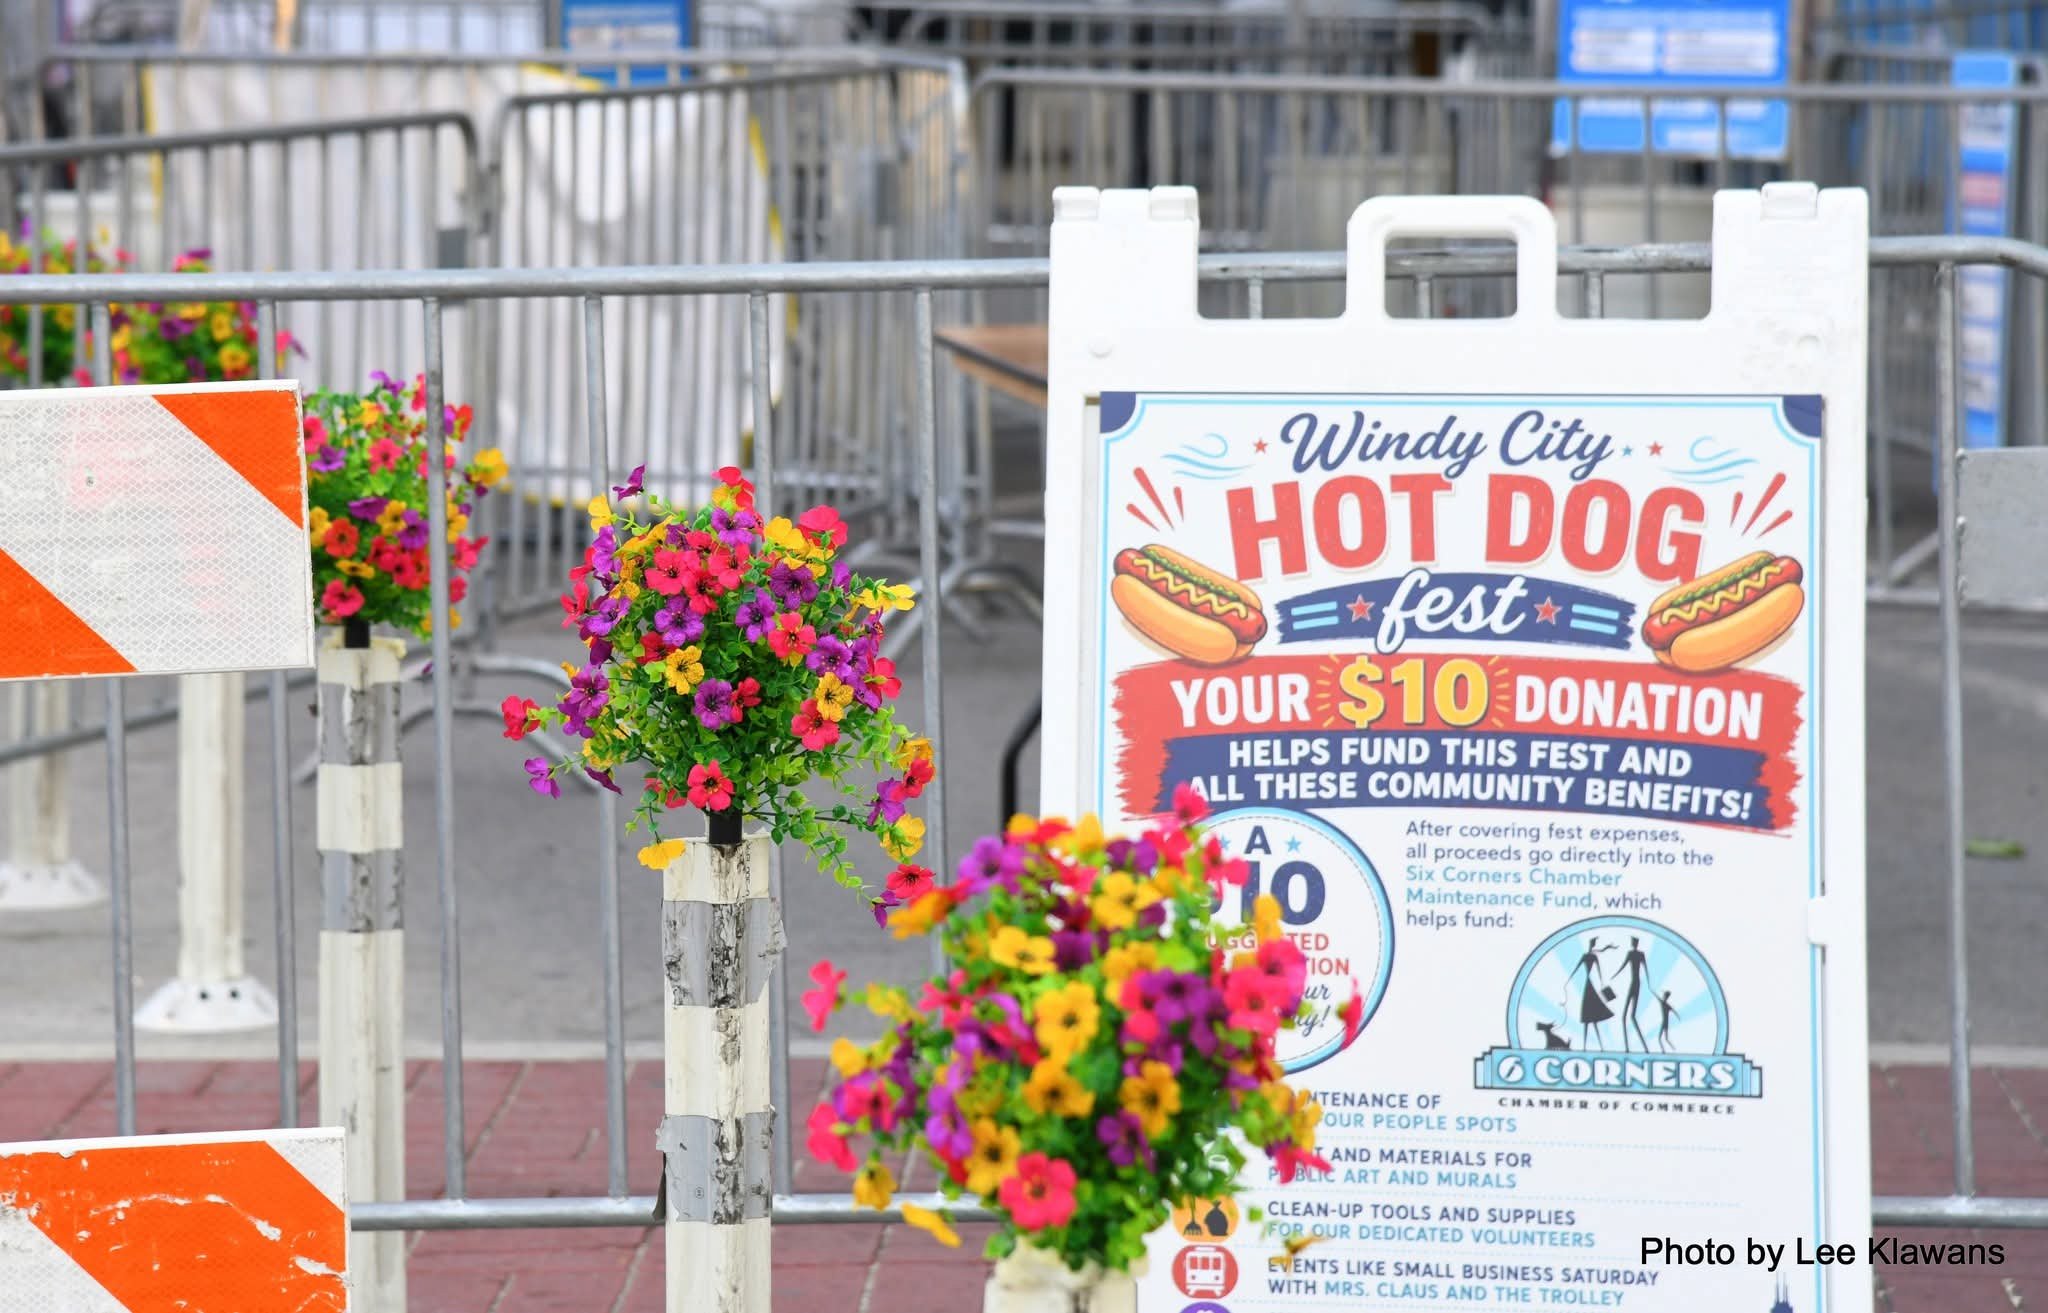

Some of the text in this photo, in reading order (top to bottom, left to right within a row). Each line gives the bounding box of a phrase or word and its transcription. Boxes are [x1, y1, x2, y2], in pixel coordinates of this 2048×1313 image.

[1280, 410, 1614, 481] Windy City
[1225, 473, 1704, 582] HOT DOG
[1376, 570, 1528, 653] fest
[1170, 655, 1762, 740] YOUR $10 DONATION
[1228, 737, 1692, 777] HELPS FUND THIS FEST AND
[1190, 771, 1752, 818] ALL THESE COMMUNITY BENEFITS!
[1244, 825, 1271, 854] A
[1406, 821, 1685, 844] After covering fest expenses,
[1406, 844, 1713, 866] all proceeds go directly into the
[1406, 865, 1622, 886] Six Corners Chamber
[1210, 861, 1326, 925] 10
[1406, 889, 1662, 910] Maintenance Fund, which
[1406, 912, 1514, 930] helps fund:
[1498, 1055, 1737, 1090] 6 CORNERS
[1307, 1091, 1441, 1109] NTENANCE OF
[1498, 1097, 1735, 1114] CHAMBER OF COMMERCE
[1373, 1113, 1447, 1130] PEOPLE
[1456, 1116, 1517, 1132] SPOTS
[1331, 1148, 1371, 1162] AND
[1380, 1149, 1486, 1166] MATERIALS
[1495, 1152, 1532, 1168] FOR
[1268, 1167, 1517, 1188] PBLIC ART AND MURALS
[1268, 1201, 1576, 1226] CLEAN-UP TOOLS AND SUPPLIES
[1268, 1222, 1595, 1248] FOR OUR DEDICATED VOLUNTEERS
[1347, 1259, 1385, 1276] LIKE
[1394, 1261, 1454, 1279] SMALL
[1462, 1264, 1553, 1282] BUSINESS
[1562, 1267, 1659, 1286] SATURDAY
[1268, 1279, 1624, 1306] WITH MRS. CLAUS AND THE TROLLEY
